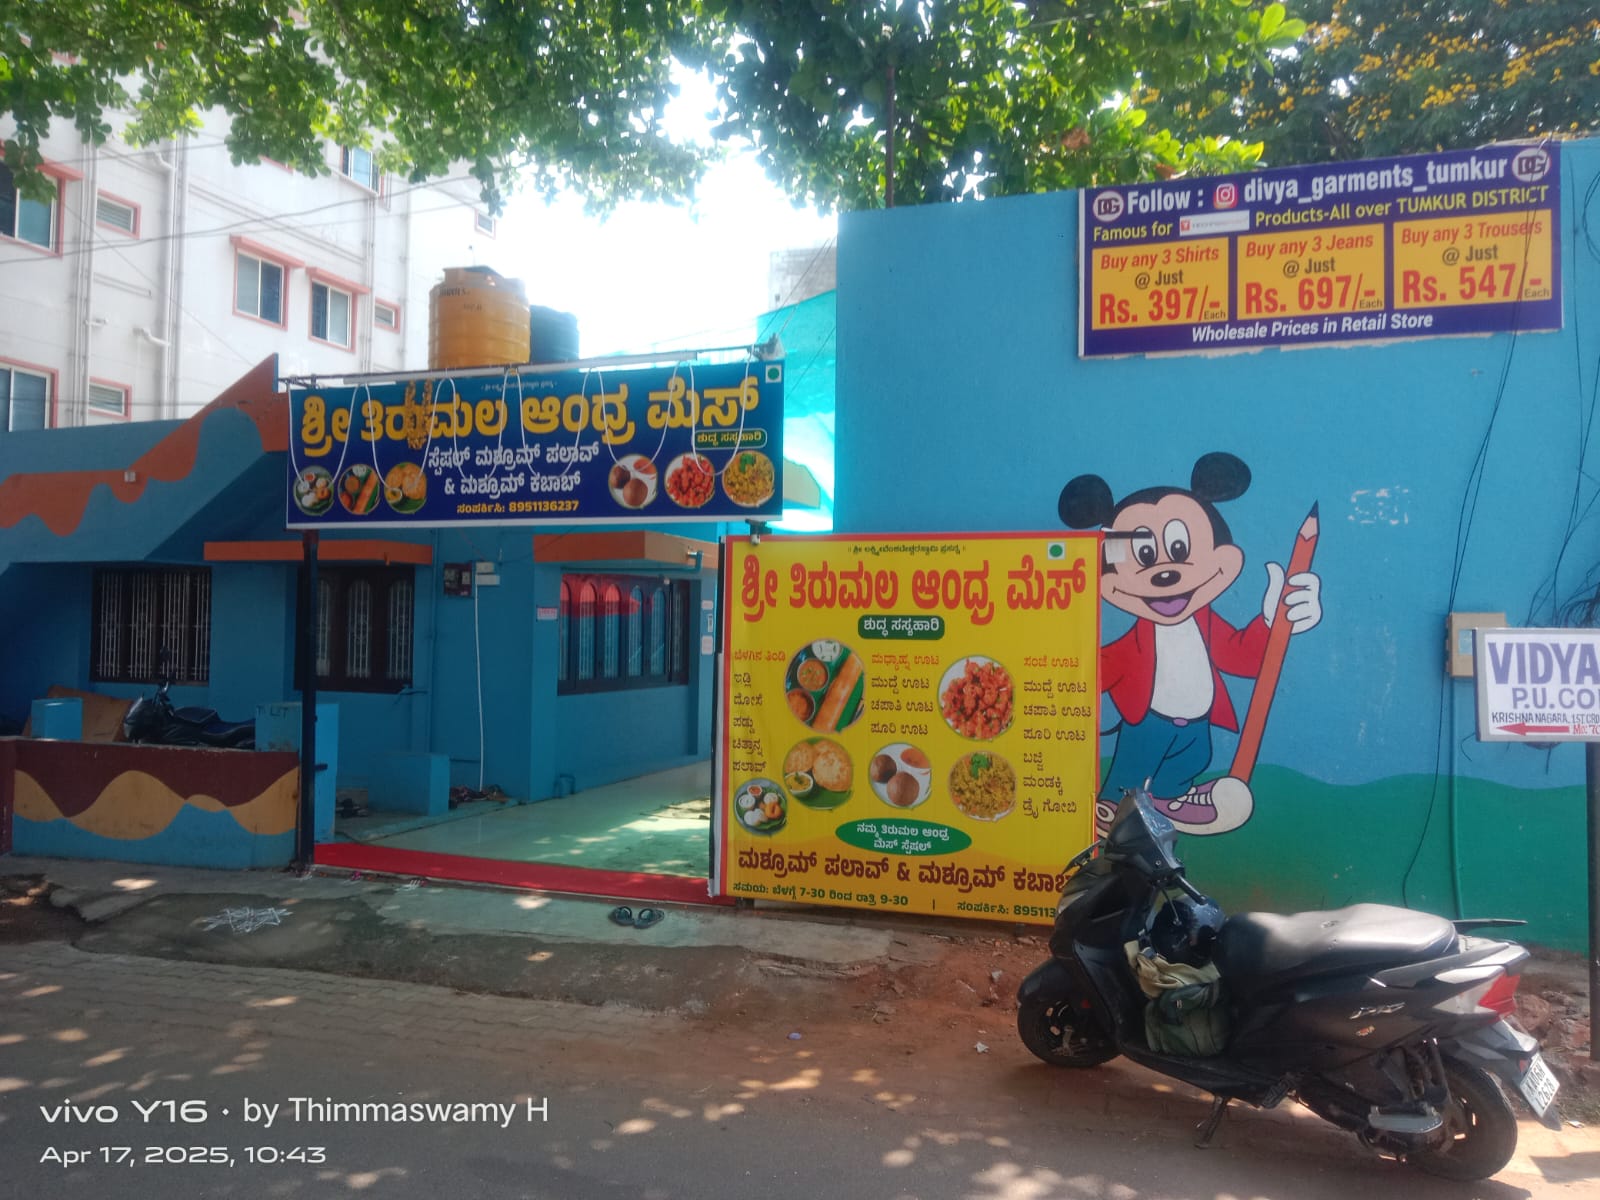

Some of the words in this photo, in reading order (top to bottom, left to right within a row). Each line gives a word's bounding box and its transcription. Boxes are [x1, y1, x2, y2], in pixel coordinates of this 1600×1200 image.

[1128, 189, 1191, 214] Follow
[1244, 156, 1508, 204] divya_garments_tumkur
[1094, 224, 1147, 242] Famous
[1151, 221, 1173, 237] for
[1355, 203, 1392, 218] over
[1397, 193, 1467, 214] TUMKUR
[1472, 185, 1548, 209] DISTRICT
[1402, 228, 1429, 246] Buy
[1433, 227, 1460, 244] any
[1464, 224, 1473, 240] 3
[1479, 221, 1542, 239] Trousers
[1246, 241, 1274, 259] Buy
[1279, 239, 1308, 257] any
[1312, 235, 1322, 252] 3
[1326, 234, 1374, 251] Jeans
[1442, 248, 1460, 266] @
[1465, 245, 1498, 262] Just
[1101, 254, 1126, 272] Buy
[1131, 252, 1158, 270] any
[1162, 249, 1171, 264] 3
[1176, 246, 1220, 264] Shirts
[1283, 260, 1299, 279] @
[1304, 257, 1336, 274] Just
[1135, 273, 1150, 290] @
[1155, 270, 1183, 286] Just
[1403, 270, 1447, 303] Rs.
[1245, 282, 1287, 314] Rs.
[1298, 273, 1376, 311] 697/-
[1525, 287, 1550, 298] Each
[1100, 293, 1138, 325] Rs.
[1149, 285, 1221, 322] 397/-
[1359, 299, 1383, 309] Each
[1203, 310, 1226, 321] Each
[1192, 320, 1267, 342] Wholesale
[1271, 319, 1319, 338] Prices
[1323, 316, 1337, 334] in
[1341, 313, 1387, 332] Retail
[1391, 313, 1433, 330] Store
[301, 395, 349, 457] ಶ್ರೀ
[647, 375, 759, 429] ಮೆಸ್
[546, 440, 600, 464] ಪಲಾವ್
[444, 479, 455, 495] &
[461, 472, 525, 499] ಮಶ್ರೂಮ್
[530, 470, 581, 493] ಕಬಾಬ್
[508, 500, 579, 513] 8951136237
[742, 554, 779, 623] ಶ್ರೀ
[789, 559, 899, 609] ತಿರುಮಲ
[1007, 554, 1086, 610] ಮೆಸ್
[1051, 656, 1079, 668] ಊಟ
[902, 677, 929, 689] ಊಟ
[1057, 681, 1087, 694] ಊಟ
[906, 701, 933, 713] ಊಟ
[1512, 687, 1600, 710] P.U.CO
[1061, 706, 1092, 718] ಊಟ
[1491, 712, 1534, 724] KRISHNA
[900, 723, 928, 735] ಊಟ
[1055, 729, 1086, 741] ಊಟ
[881, 824, 919, 836] ತಿರುಮಲ
[874, 837, 898, 849] ಮೆಸ್
[738, 848, 817, 878] ಮಶ್ರೂಮ್
[824, 853, 889, 879] ಪಲಾವ್
[897, 862, 911, 882] &
[918, 861, 1005, 893] ಮಶ್ರೂಮ್
[1013, 867, 1071, 893] ಕಬಾಬ
[800, 887, 825, 898] 7-30
[880, 895, 908, 906] 9-30
